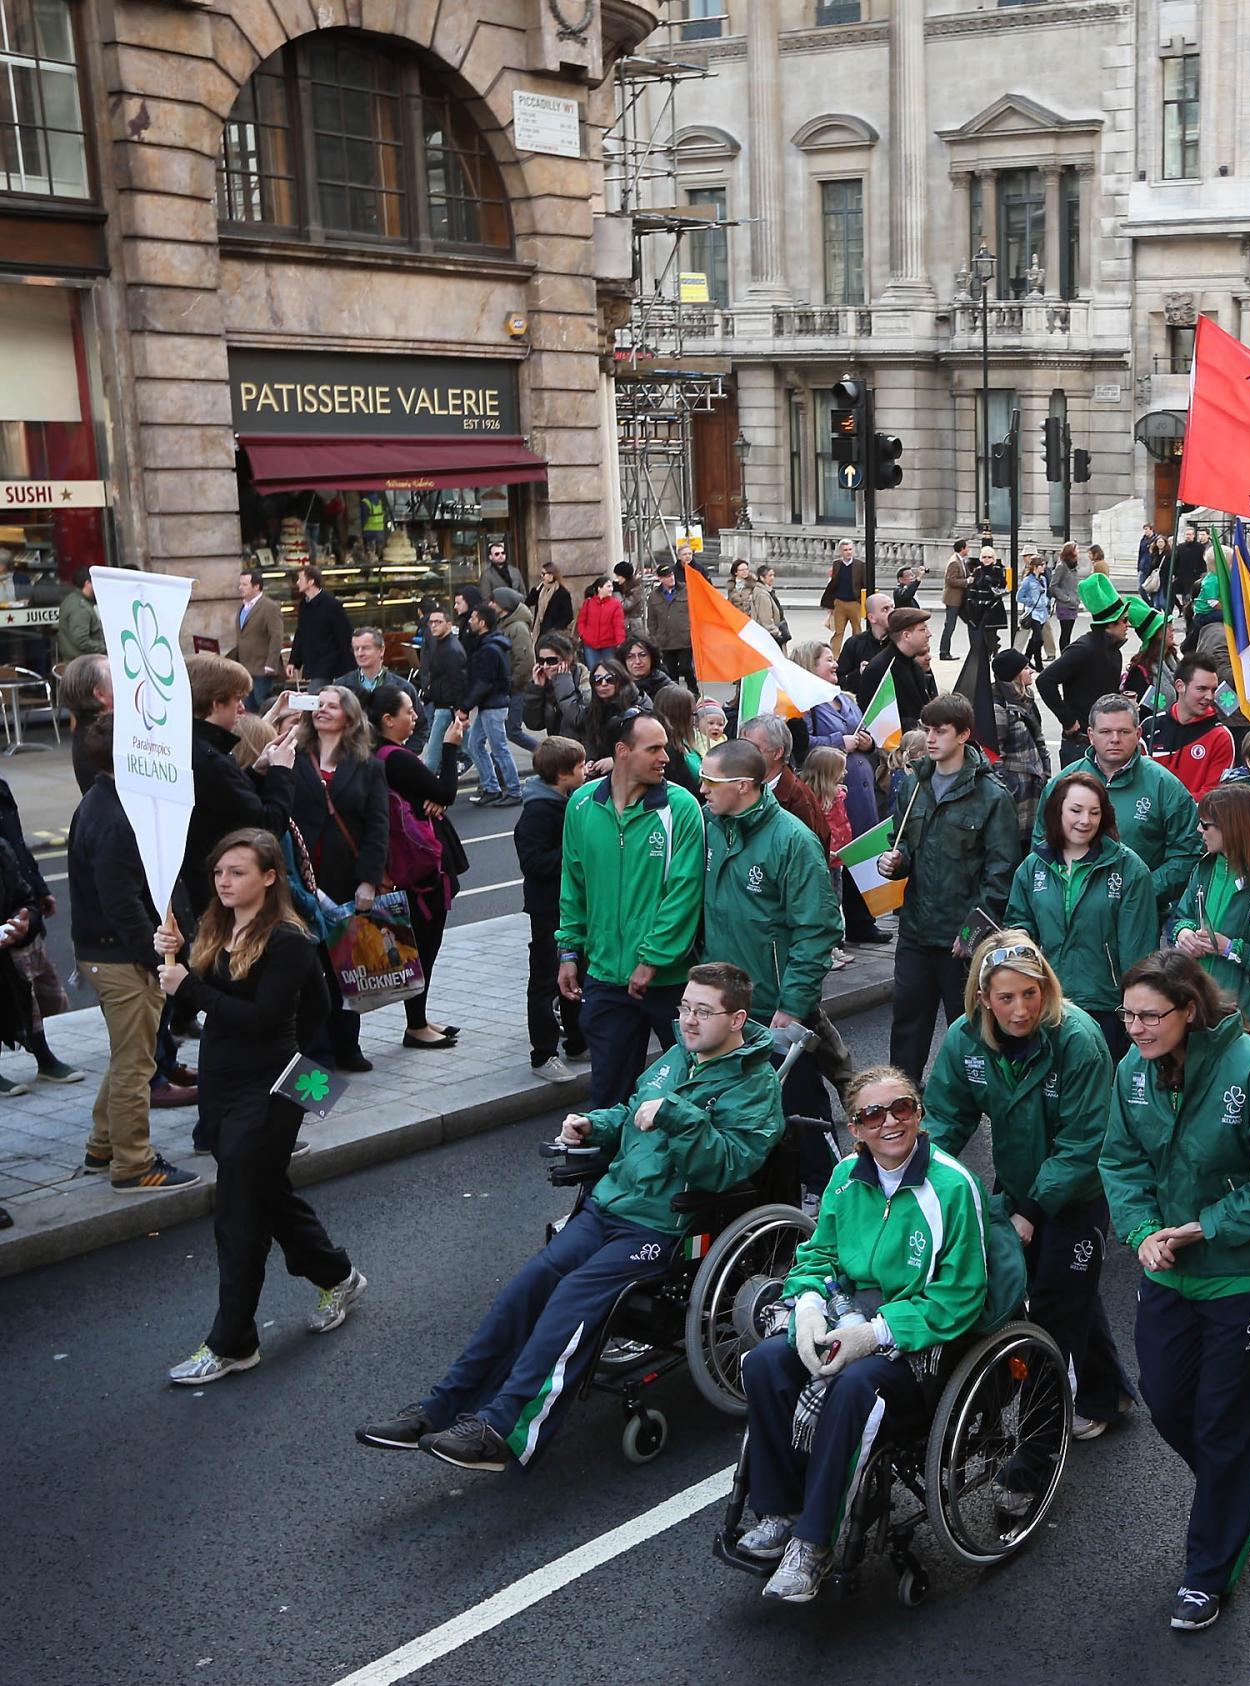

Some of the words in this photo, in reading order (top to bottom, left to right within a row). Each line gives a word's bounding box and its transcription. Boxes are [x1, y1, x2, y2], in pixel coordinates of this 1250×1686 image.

[518, 95, 561, 112] PICCADILLY
[240, 383, 391, 414] PATISSERIE
[397, 387, 499, 416] VALERIE
[463, 419, 479, 429] EST
[482, 420, 500, 429] 1926
[5, 486, 53, 503] SUSHI
[26, 610, 60, 623] JUICES
[132, 735, 171, 757] Paralympics
[127, 752, 178, 783] IRELAND
